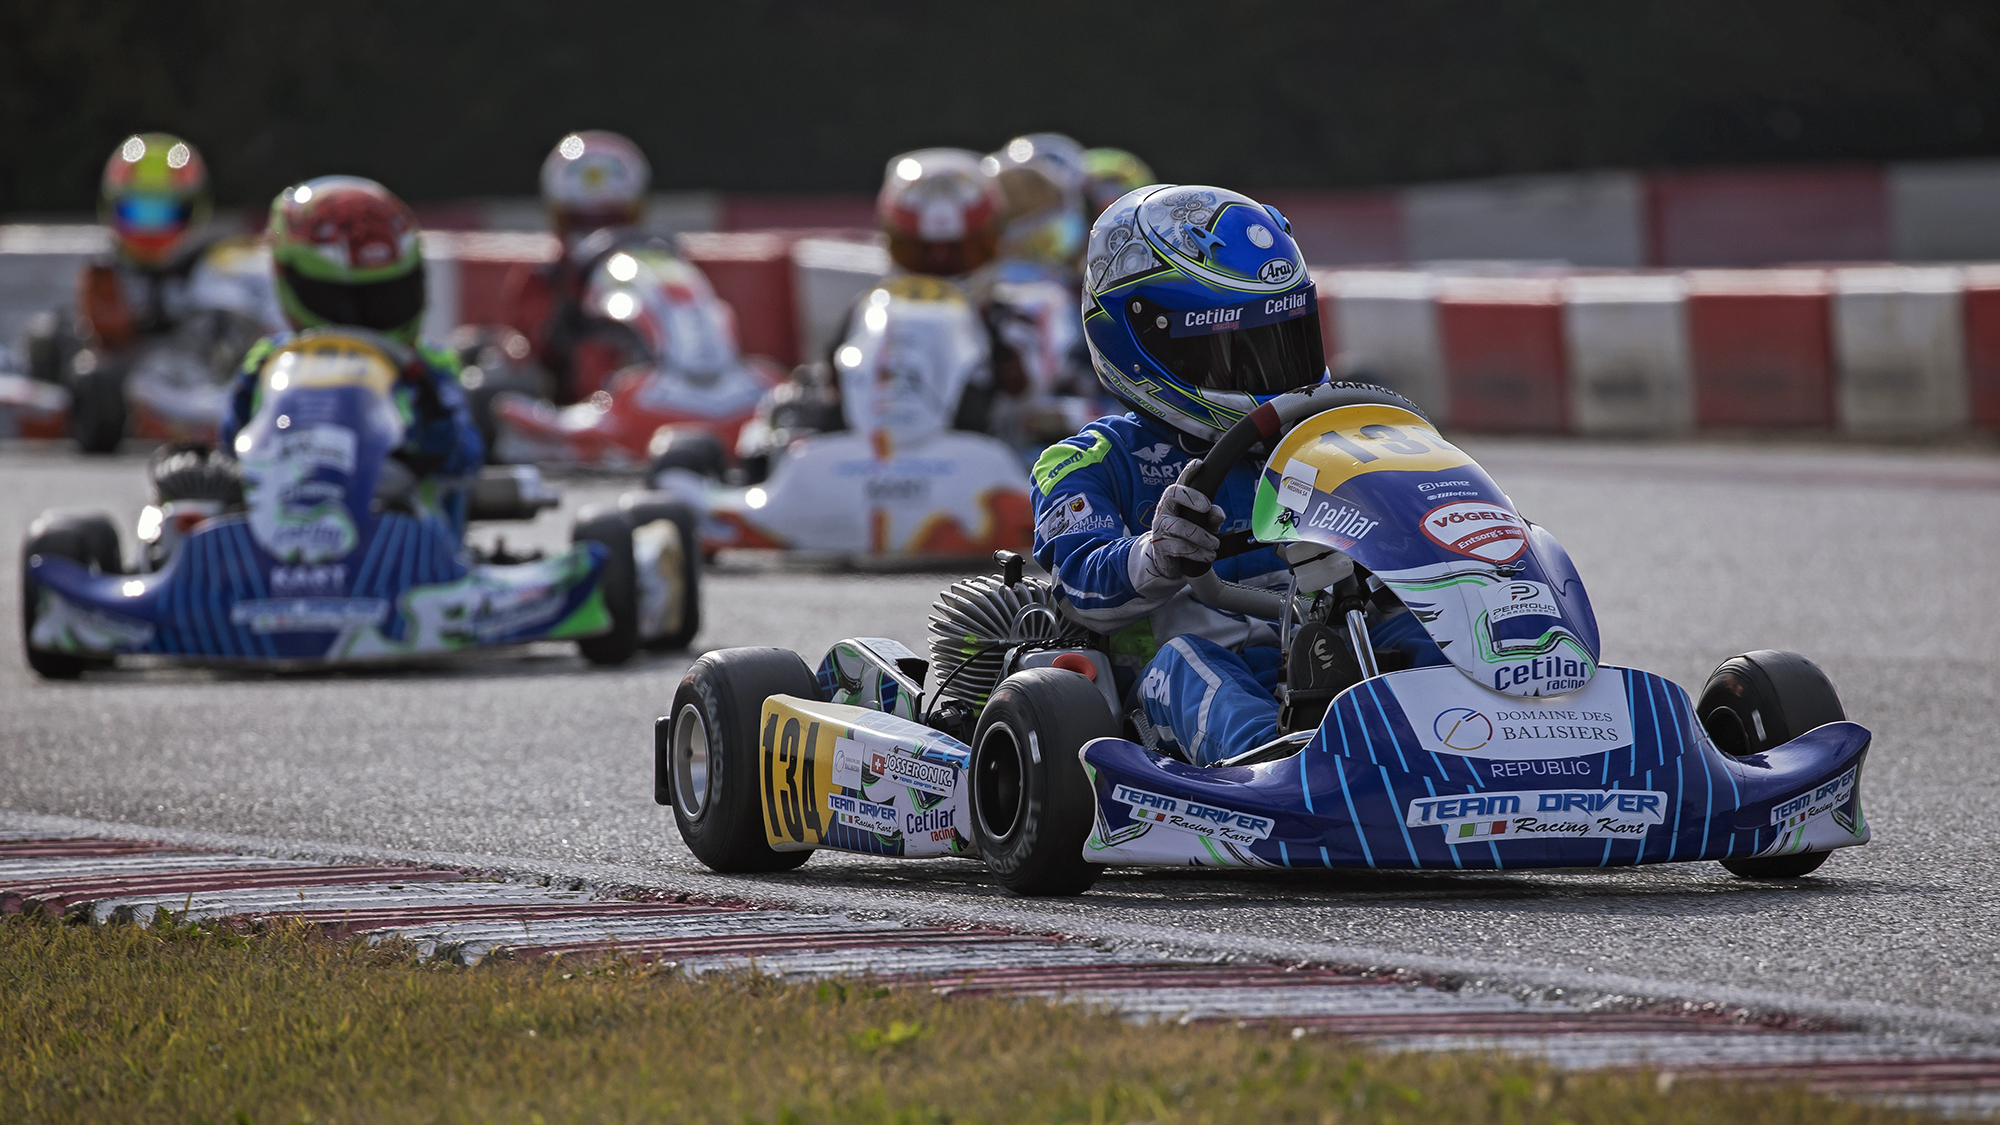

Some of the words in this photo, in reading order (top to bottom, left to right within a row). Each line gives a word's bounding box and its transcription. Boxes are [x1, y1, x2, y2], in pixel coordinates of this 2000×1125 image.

[1263, 261, 1291, 280] Arai
[1265, 293, 1307, 315] Cetilar
[1185, 307, 1243, 327] Cetilar
[1212, 321, 1239, 331] racing
[1138, 461, 1183, 478] KART
[1308, 501, 1380, 540] Cetilar
[1325, 534, 1357, 550] racing
[1493, 603, 1556, 615] PERROUD
[1493, 608, 1557, 620] CARROSSERIE
[1494, 656, 1588, 691] Cetilar
[1496, 711, 1578, 721] DOMAINE
[1582, 711, 1613, 722] DES
[1501, 726, 1618, 741] BALISIERS
[884, 753, 938, 784] JOSSERON
[762, 713, 825, 845] 134
[1773, 793, 1811, 821] TEAM
[1815, 769, 1855, 802] DRIVER
[829, 794, 856, 813] TEAM
[859, 801, 898, 825] DRIVER
[1118, 786, 1177, 812] TEAM
[1185, 803, 1269, 837] DRIVER
[1414, 795, 1521, 822] TEAM
[1537, 793, 1663, 819] DRIVER
[1807, 802, 1833, 819] Racing
[853, 815, 876, 831] Racing
[875, 821, 892, 833] Kart
[906, 808, 956, 835] Cetilar
[1169, 815, 1215, 837] Racing
[1219, 827, 1252, 843] Kart
[1513, 817, 1591, 836] Racing
[1597, 817, 1645, 834] Kart
[930, 827, 957, 842] racing
